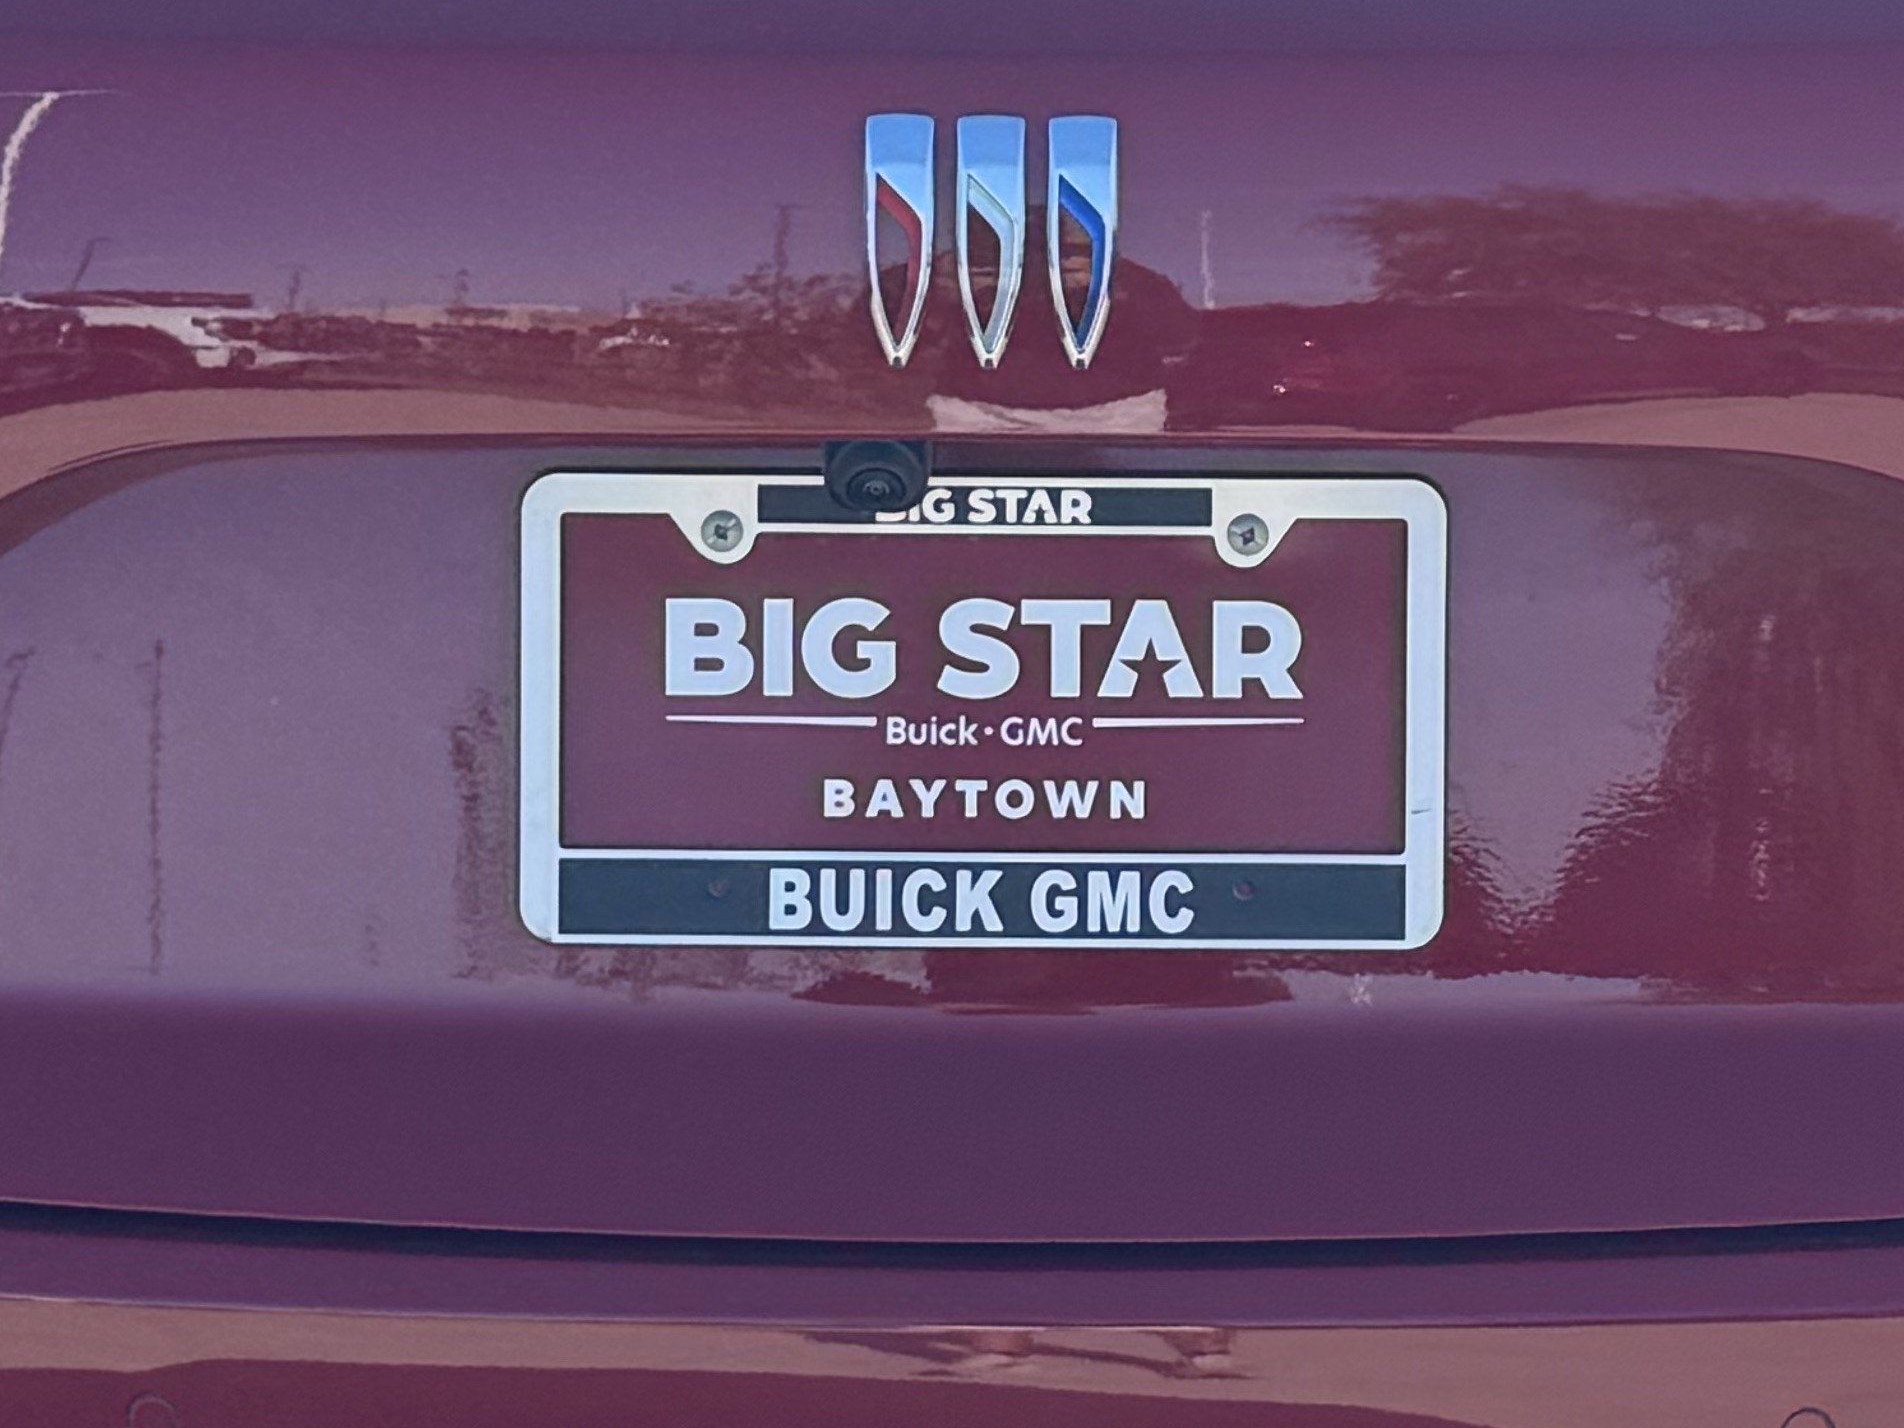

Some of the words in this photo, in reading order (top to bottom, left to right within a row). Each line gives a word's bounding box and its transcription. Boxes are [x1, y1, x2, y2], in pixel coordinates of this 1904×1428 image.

[875, 488, 956, 523] IG
[967, 488, 1093, 524] STAR
[665, 597, 897, 699] BIG
[936, 597, 1304, 700] STAR
[885, 715, 979, 746] Buick
[1000, 716, 1084, 747] GMC
[823, 778, 1146, 820] BAYTOWN
[768, 868, 1005, 932] BUICK
[1030, 869, 1195, 934] GMC
